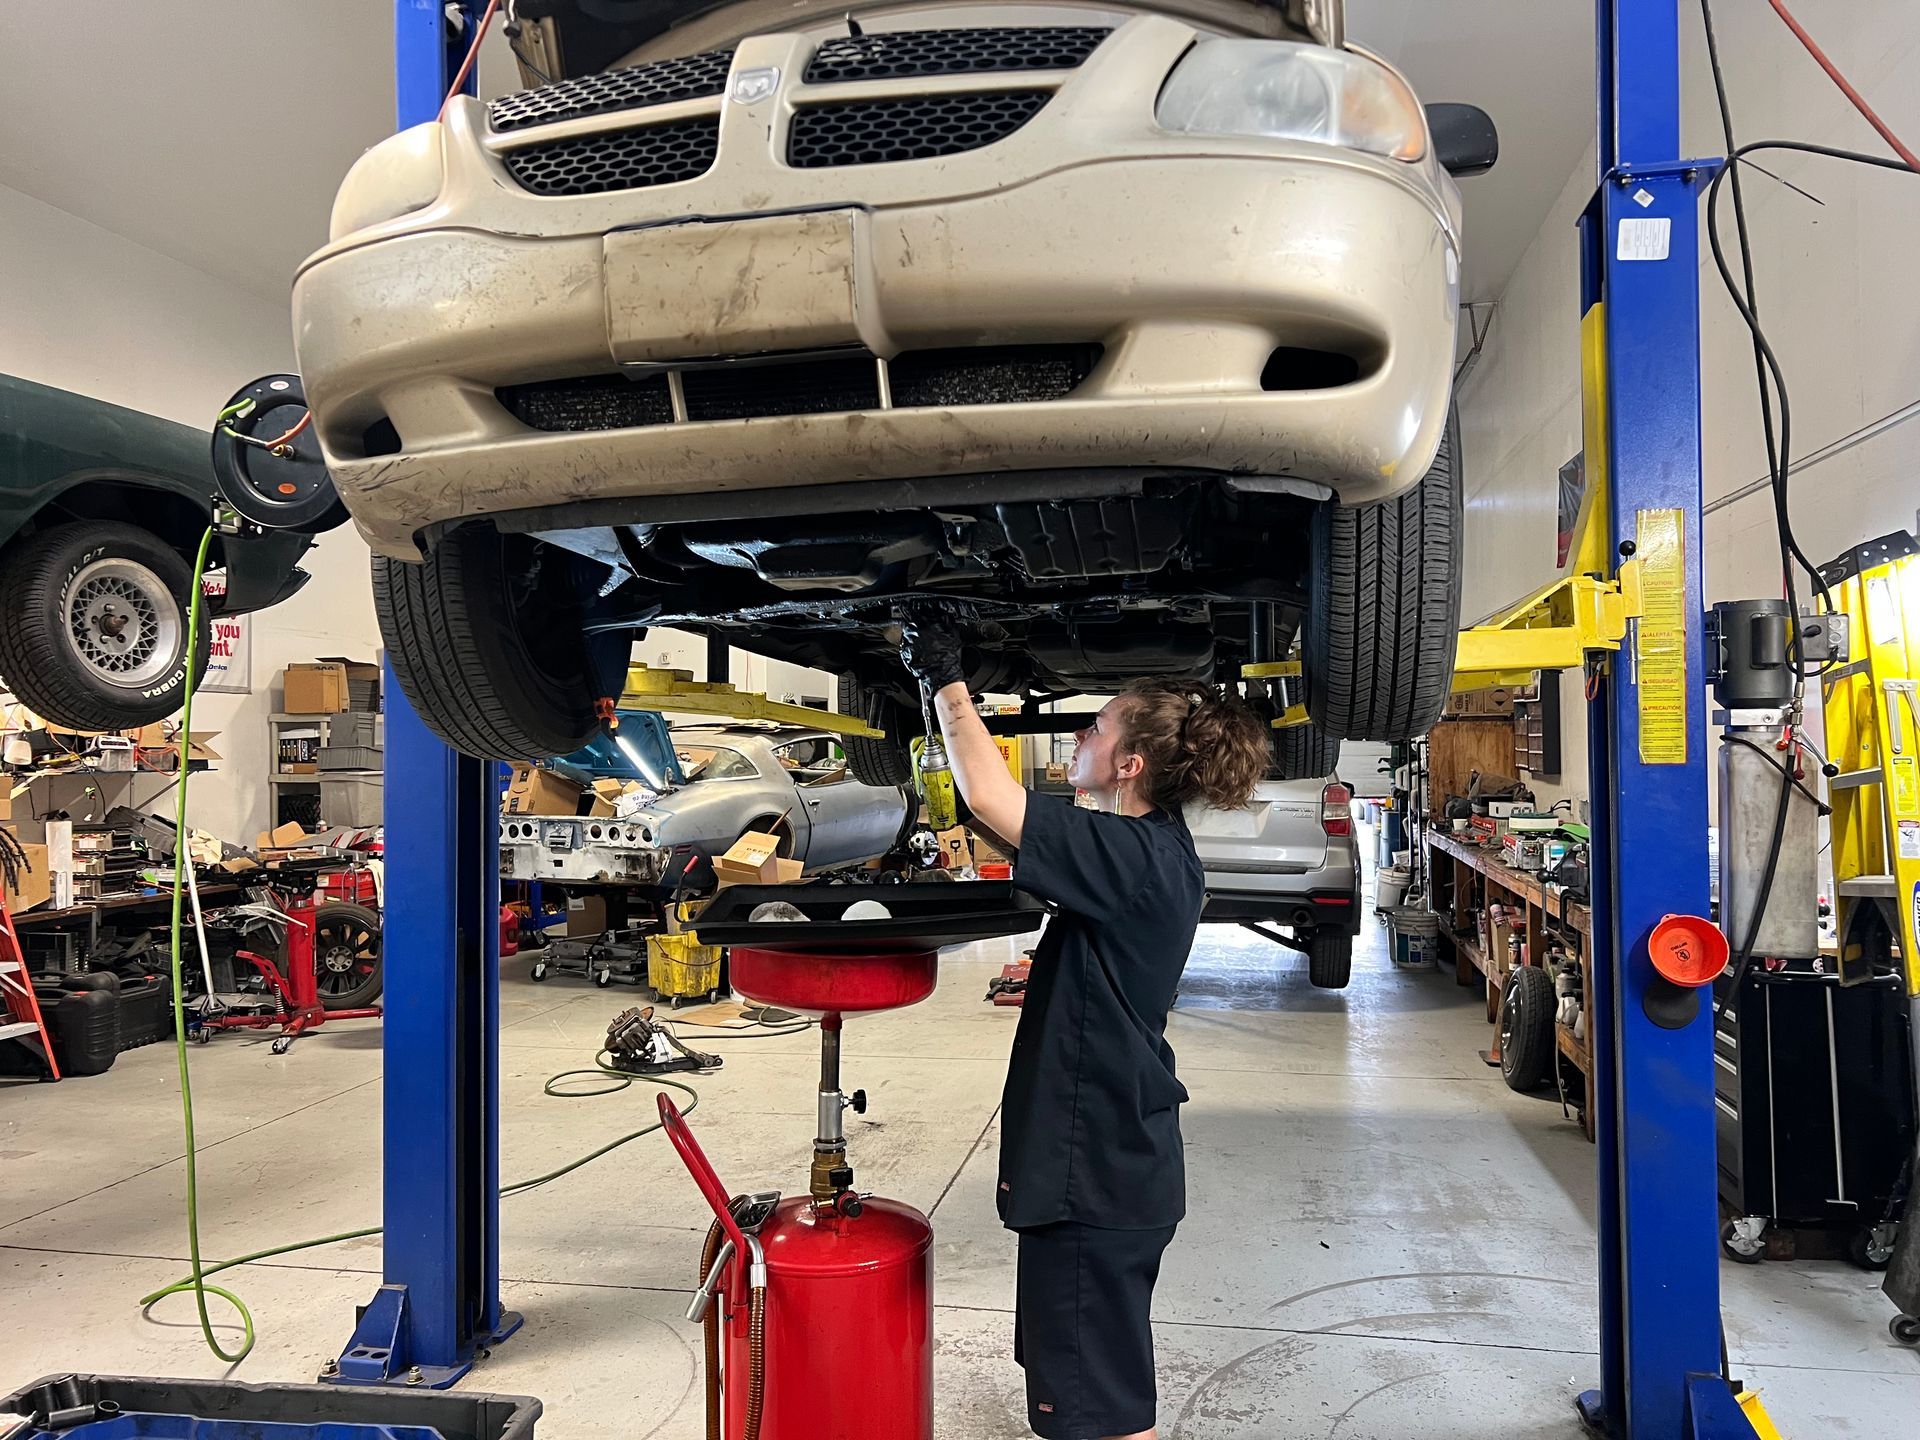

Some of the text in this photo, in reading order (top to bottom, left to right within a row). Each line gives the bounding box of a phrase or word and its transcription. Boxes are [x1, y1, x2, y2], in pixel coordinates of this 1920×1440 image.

[216, 623, 240, 640] you
[210, 640, 233, 657] ant.
[142, 669, 185, 699] COBRA
[746, 847, 770, 855] DEPO
